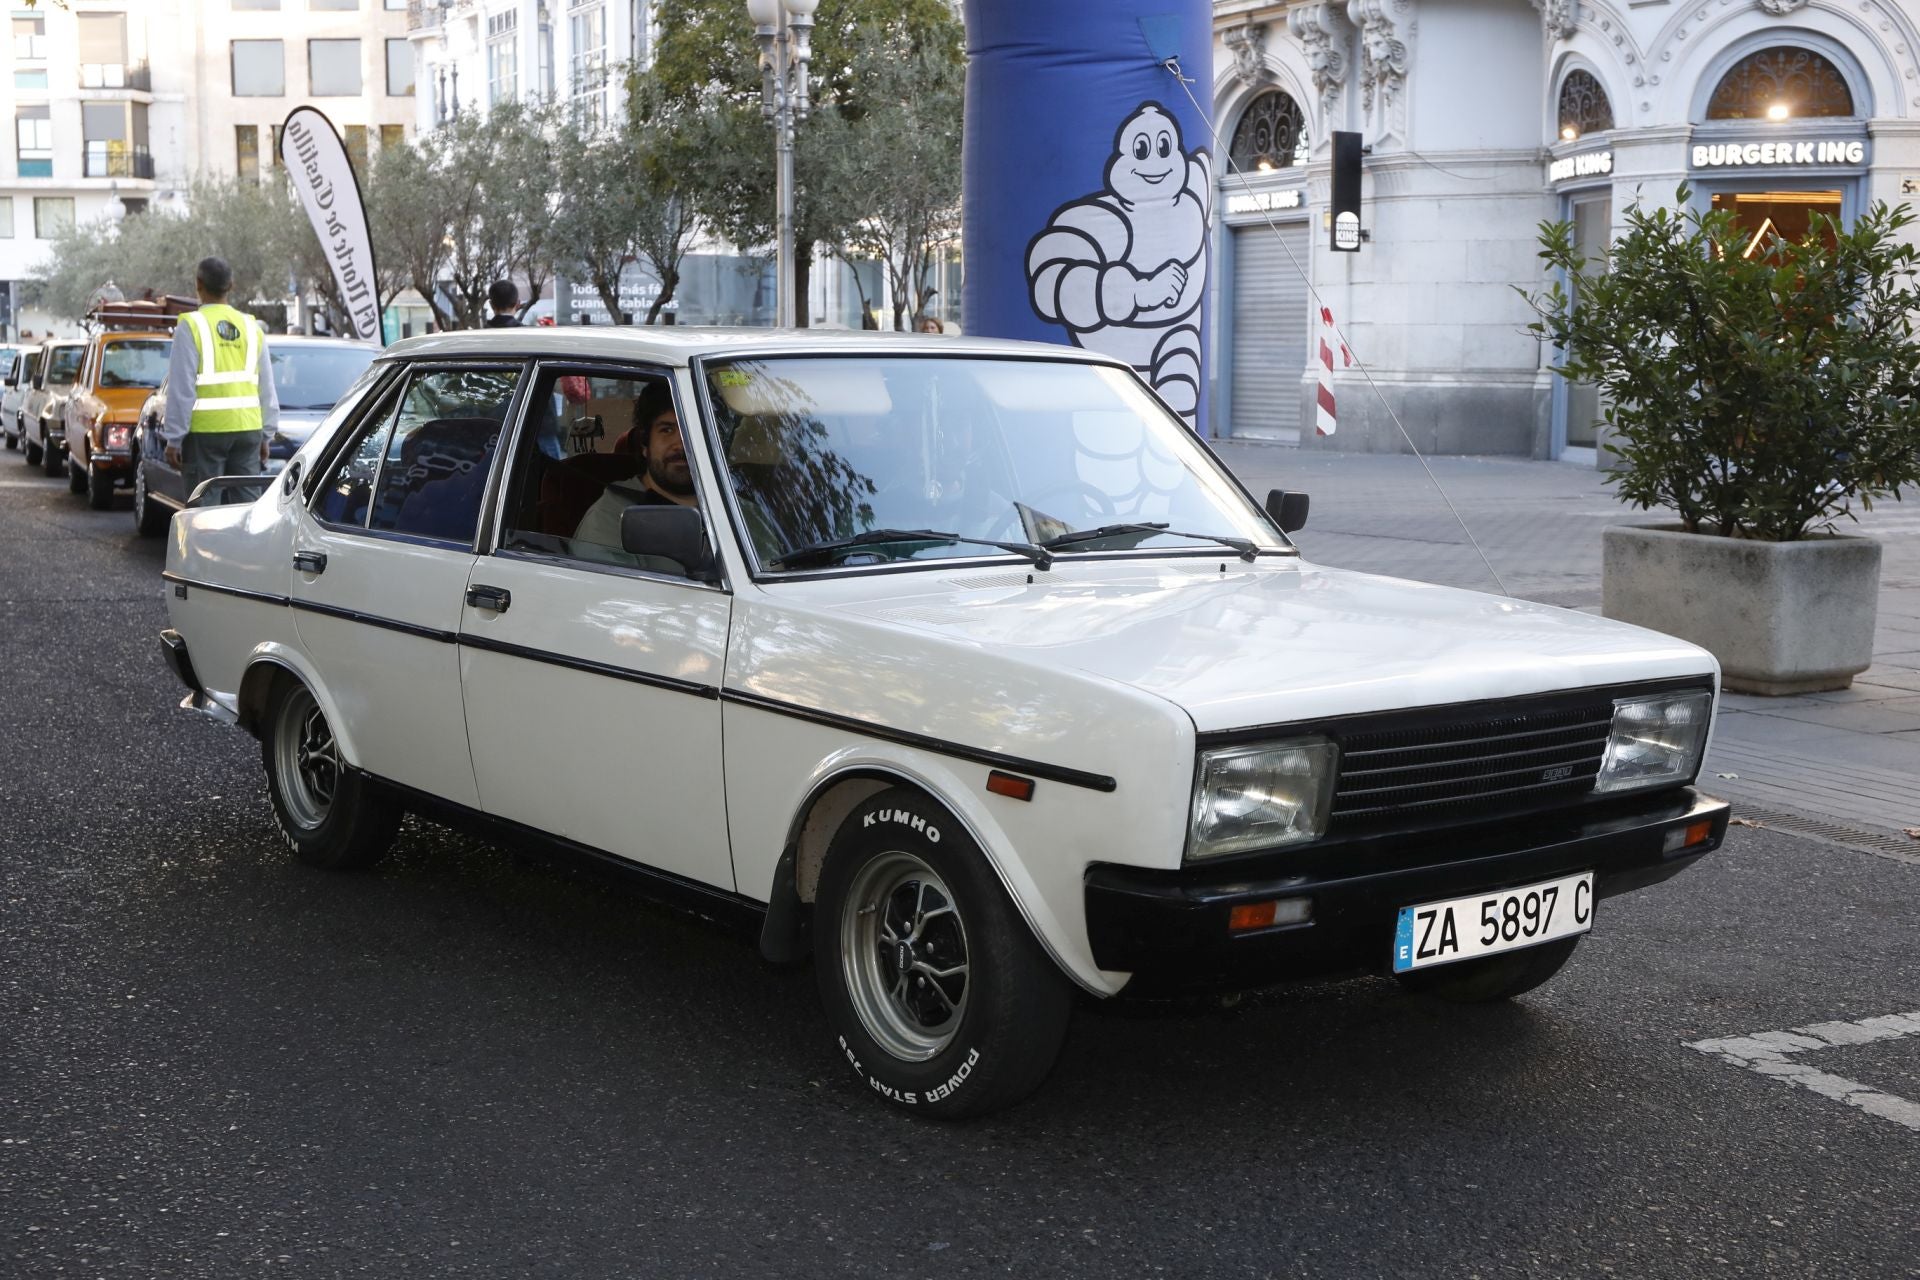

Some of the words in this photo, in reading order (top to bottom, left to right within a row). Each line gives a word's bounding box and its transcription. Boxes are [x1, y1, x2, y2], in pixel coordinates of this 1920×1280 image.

[1575, 152, 1612, 176] KING
[1692, 142, 1794, 167] BURGER
[1336, 230, 1359, 242] KING
[570, 282, 600, 295] Todo
[863, 808, 941, 843] KUMHO
[1399, 945, 1409, 960] E
[1416, 906, 1460, 960] ZA
[1480, 885, 1560, 946] 5897
[1574, 879, 1590, 925] C
[924, 1047, 981, 1103] POWER
[869, 1075, 918, 1105] STAR
